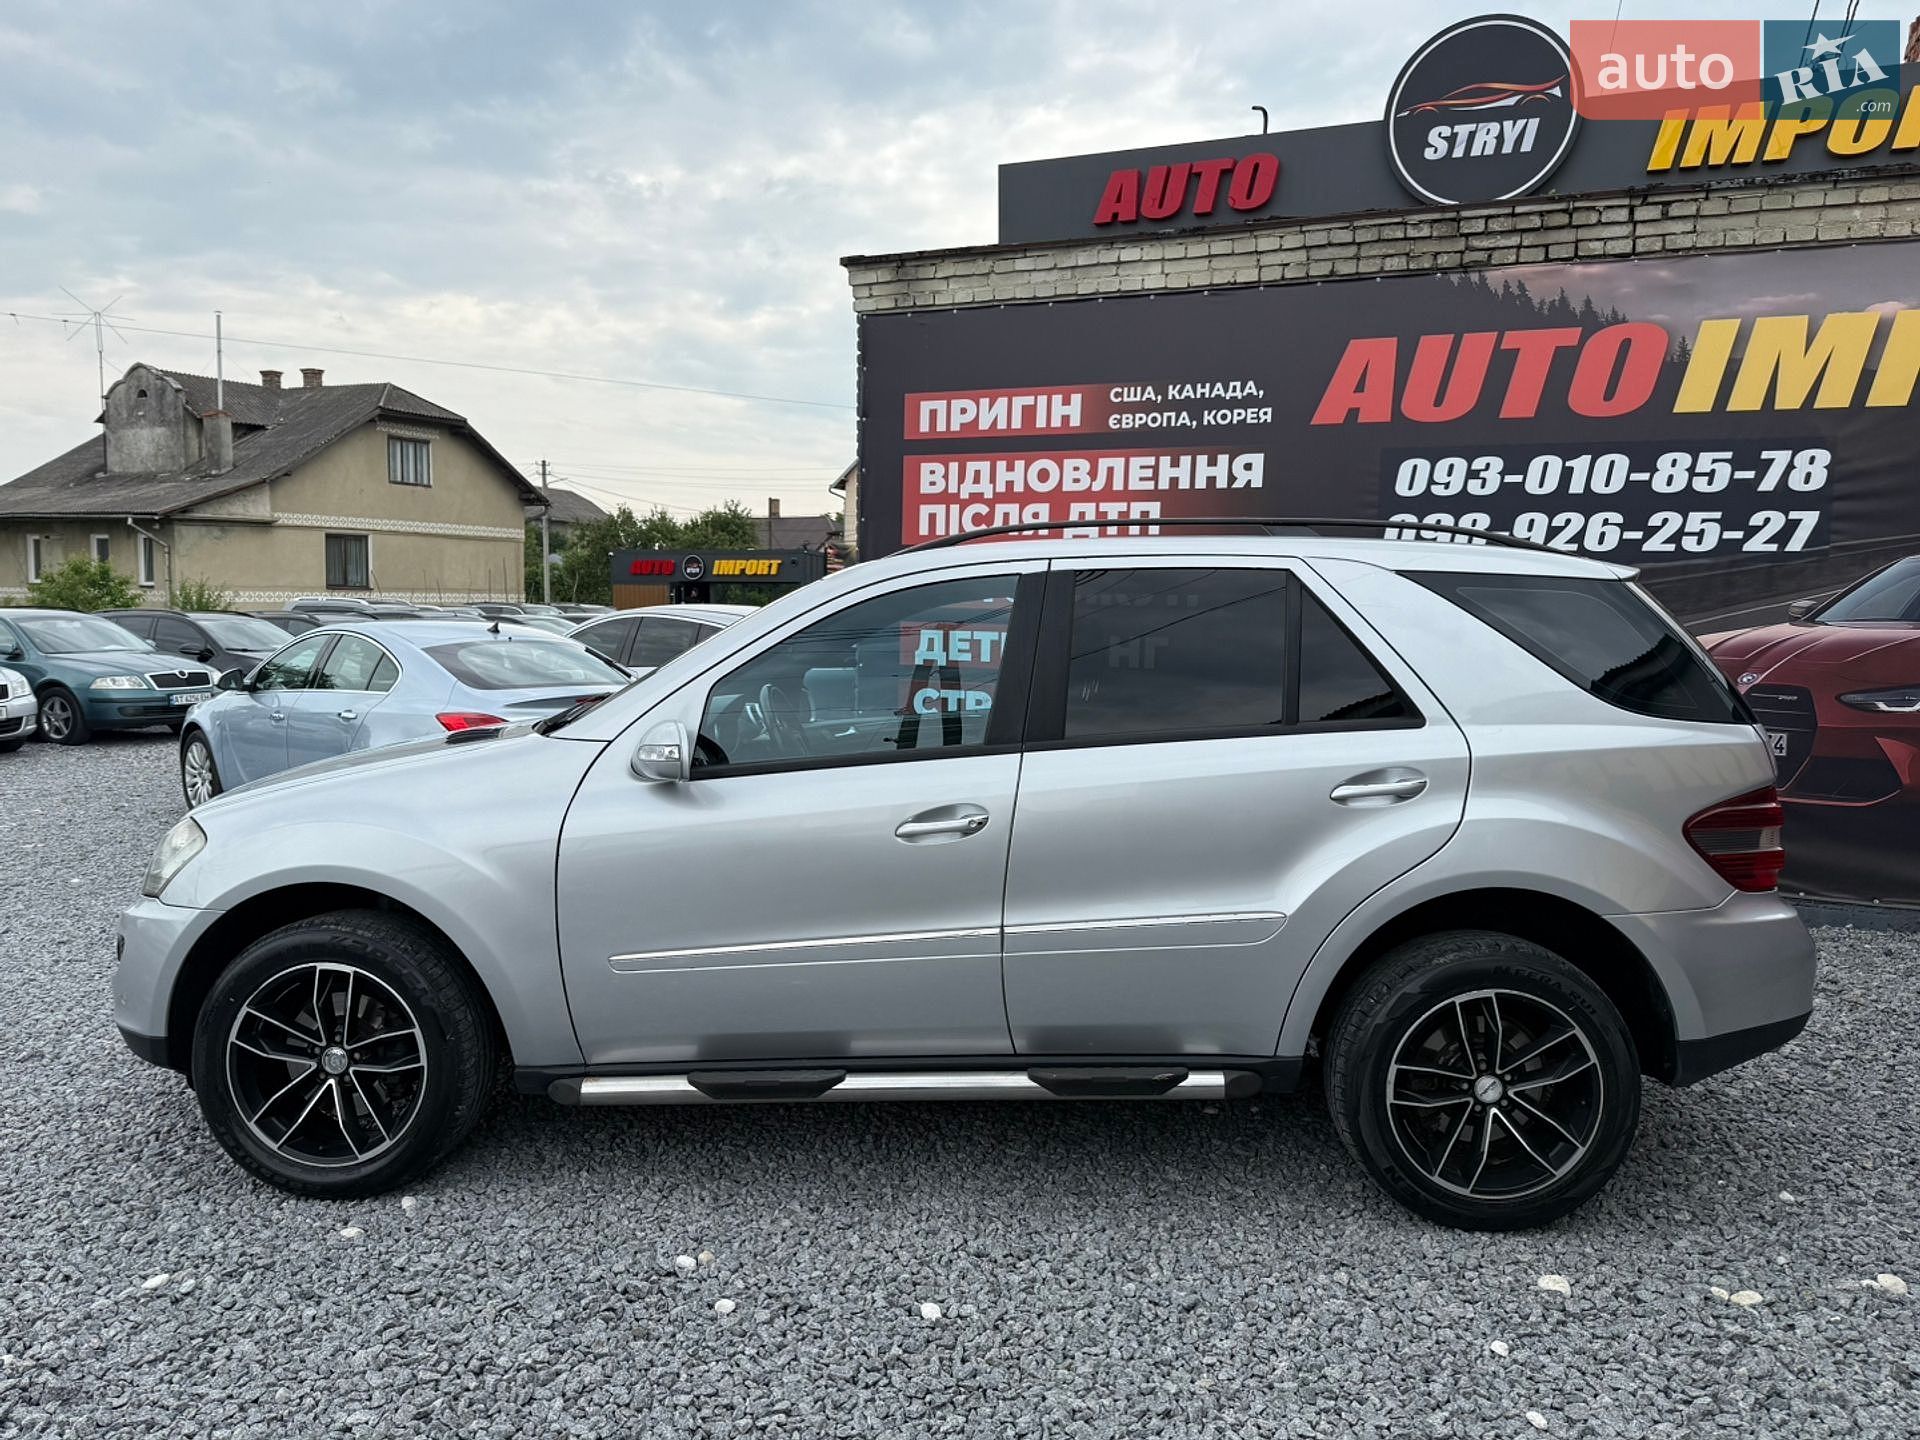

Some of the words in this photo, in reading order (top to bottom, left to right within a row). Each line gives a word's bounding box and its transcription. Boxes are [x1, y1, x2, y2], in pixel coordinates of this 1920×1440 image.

[1423, 117, 1540, 161] STRYI
[1093, 153, 1280, 226] AUTO
[1109, 385, 1162, 404] США,
[1167, 380, 1264, 401] КАНАДА,
[919, 393, 1083, 433] ПРИГІН
[1108, 412, 1197, 430] ЄВРОПА,
[1203, 407, 1272, 426] КОРЕЯ
[919, 453, 1265, 499] ВІДНОВЛЕННЯ
[1394, 448, 1832, 496] 093-010-85-78
[918, 503, 1050, 536] ПІСЛЯ
[1063, 501, 1162, 539] ДТП
[630, 559, 676, 577] AUTO
[711, 559, 783, 576] IMPORT
